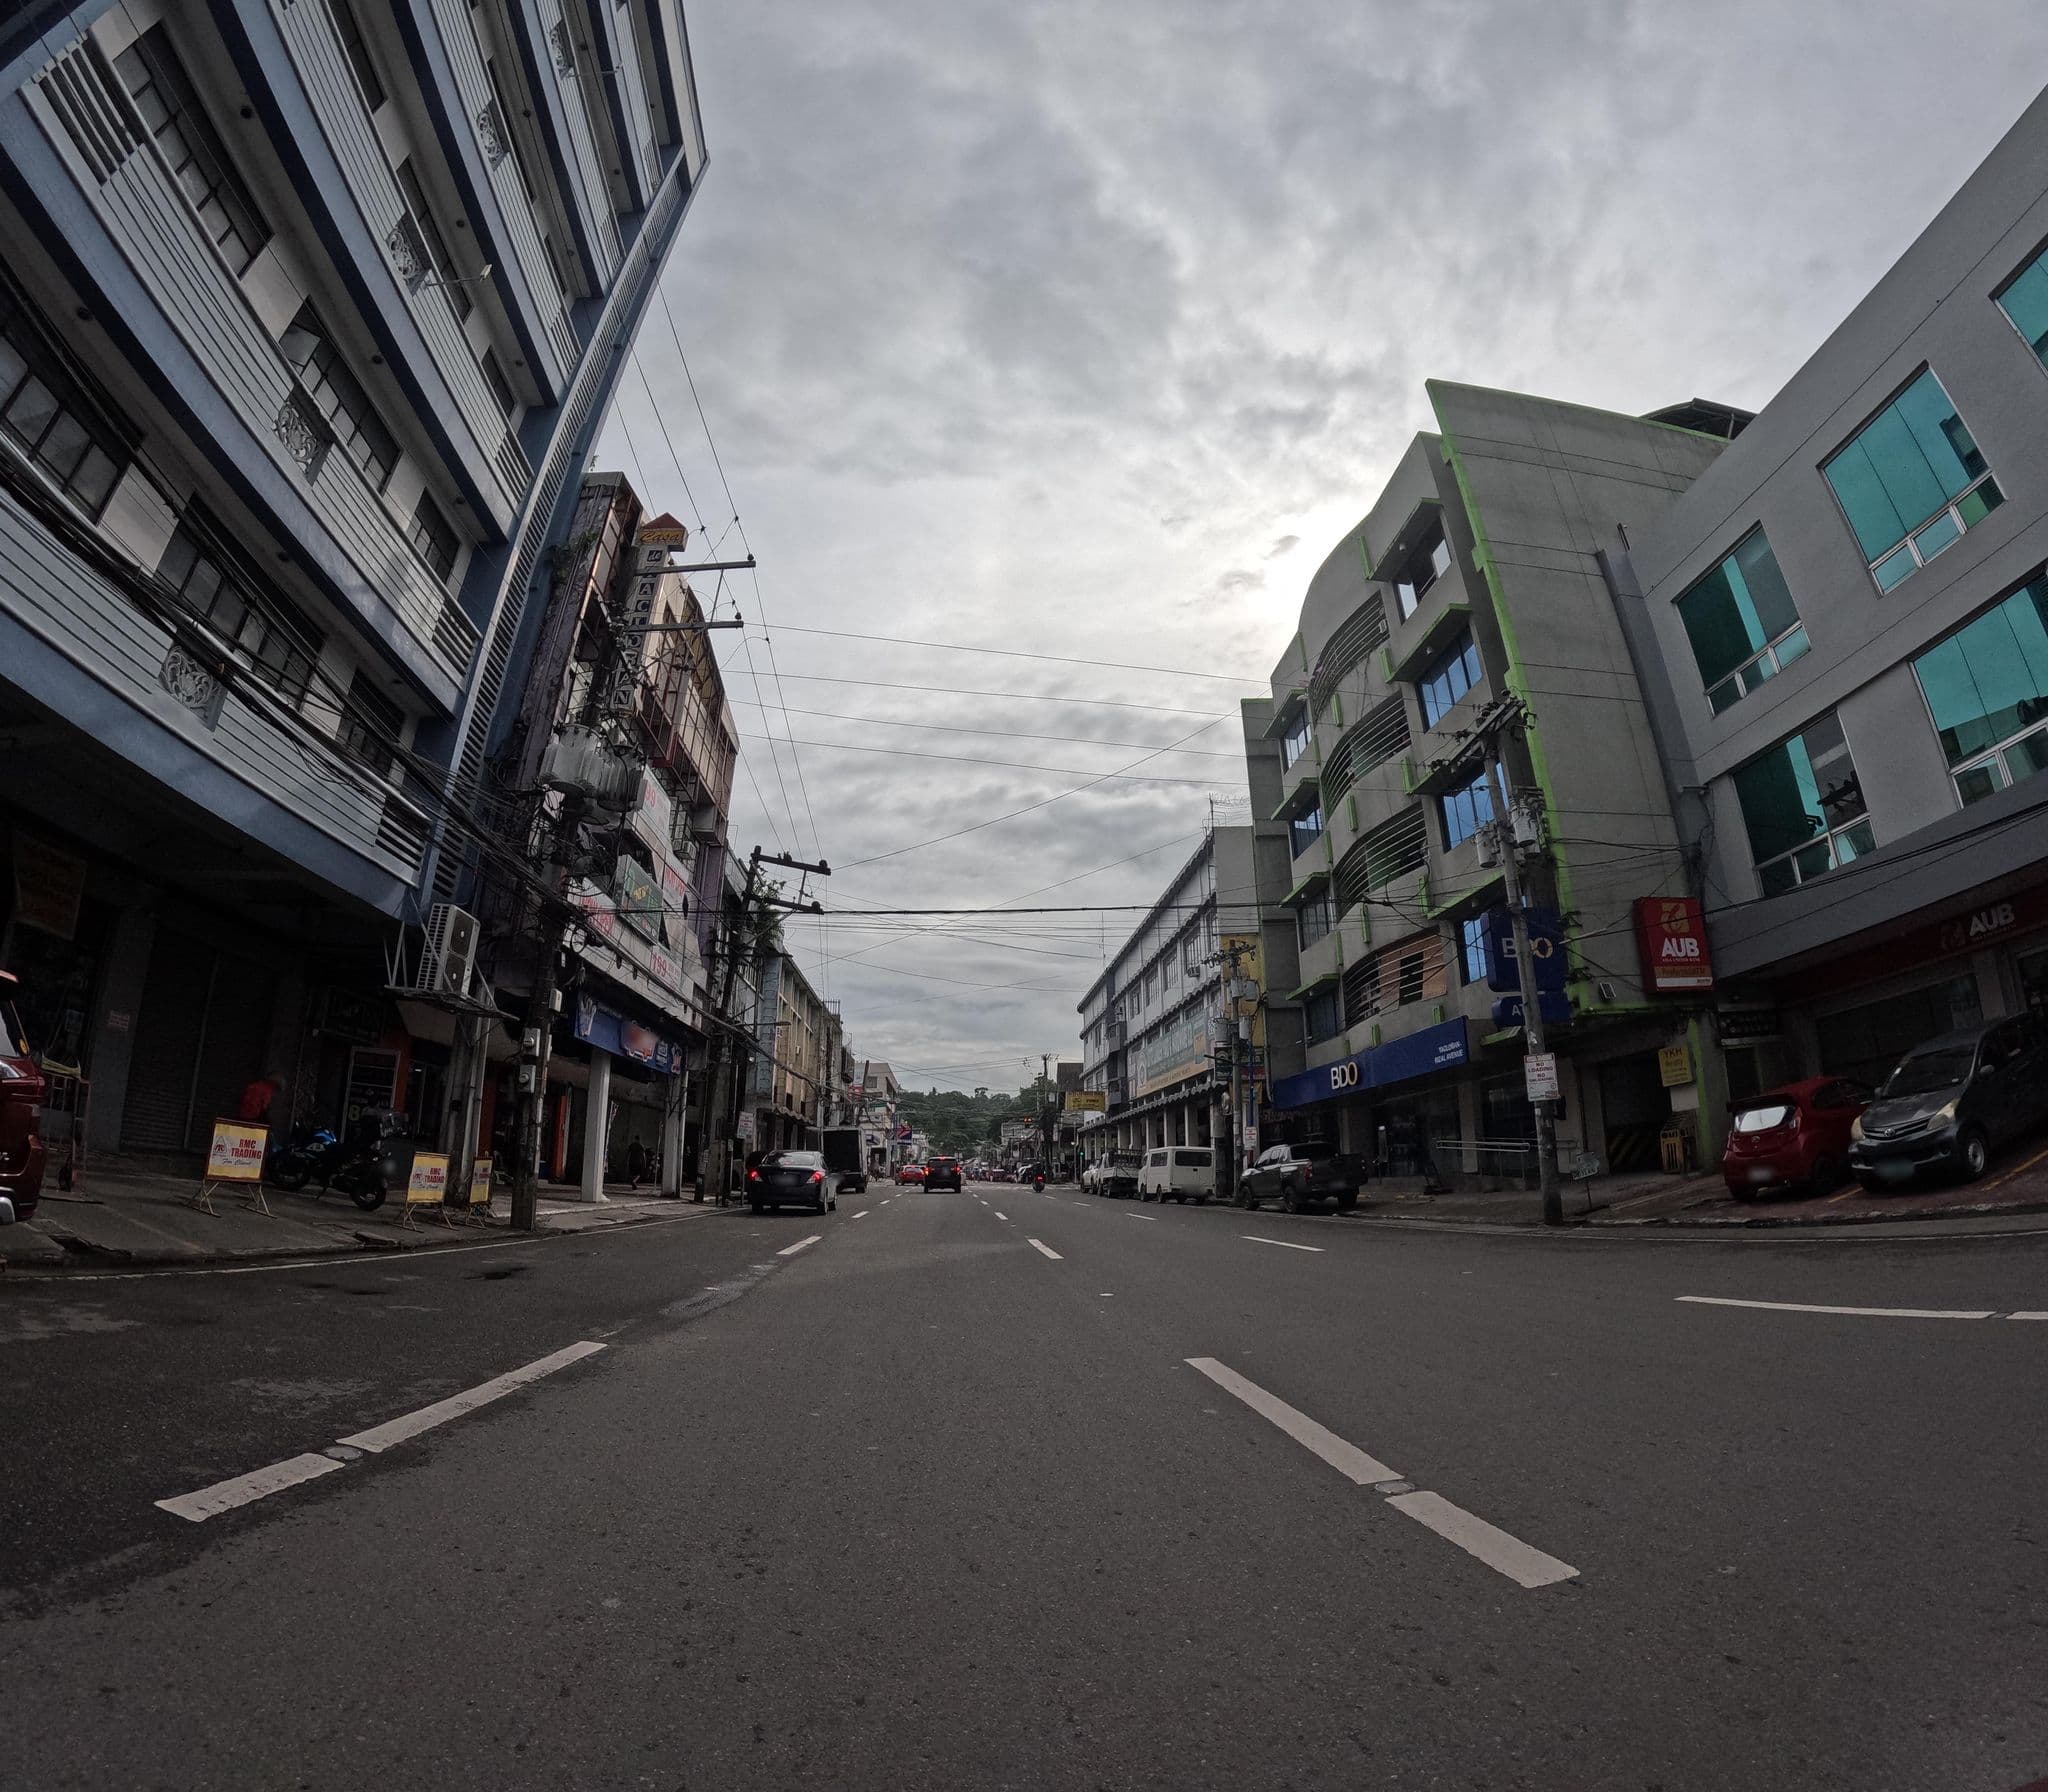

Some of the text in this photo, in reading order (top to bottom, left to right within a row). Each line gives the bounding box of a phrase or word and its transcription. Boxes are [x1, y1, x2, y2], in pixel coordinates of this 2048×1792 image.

[640, 530, 680, 543] Casa
[1968, 903, 2015, 937] AUB
[1501, 936, 1554, 959] BO
[1661, 937, 1700, 958] AUB
[1330, 1061, 1358, 1090] BDO
[238, 1138, 257, 1149] RMC
[231, 1148, 263, 1160] TRADING
[424, 1175, 445, 1184] TRADING
